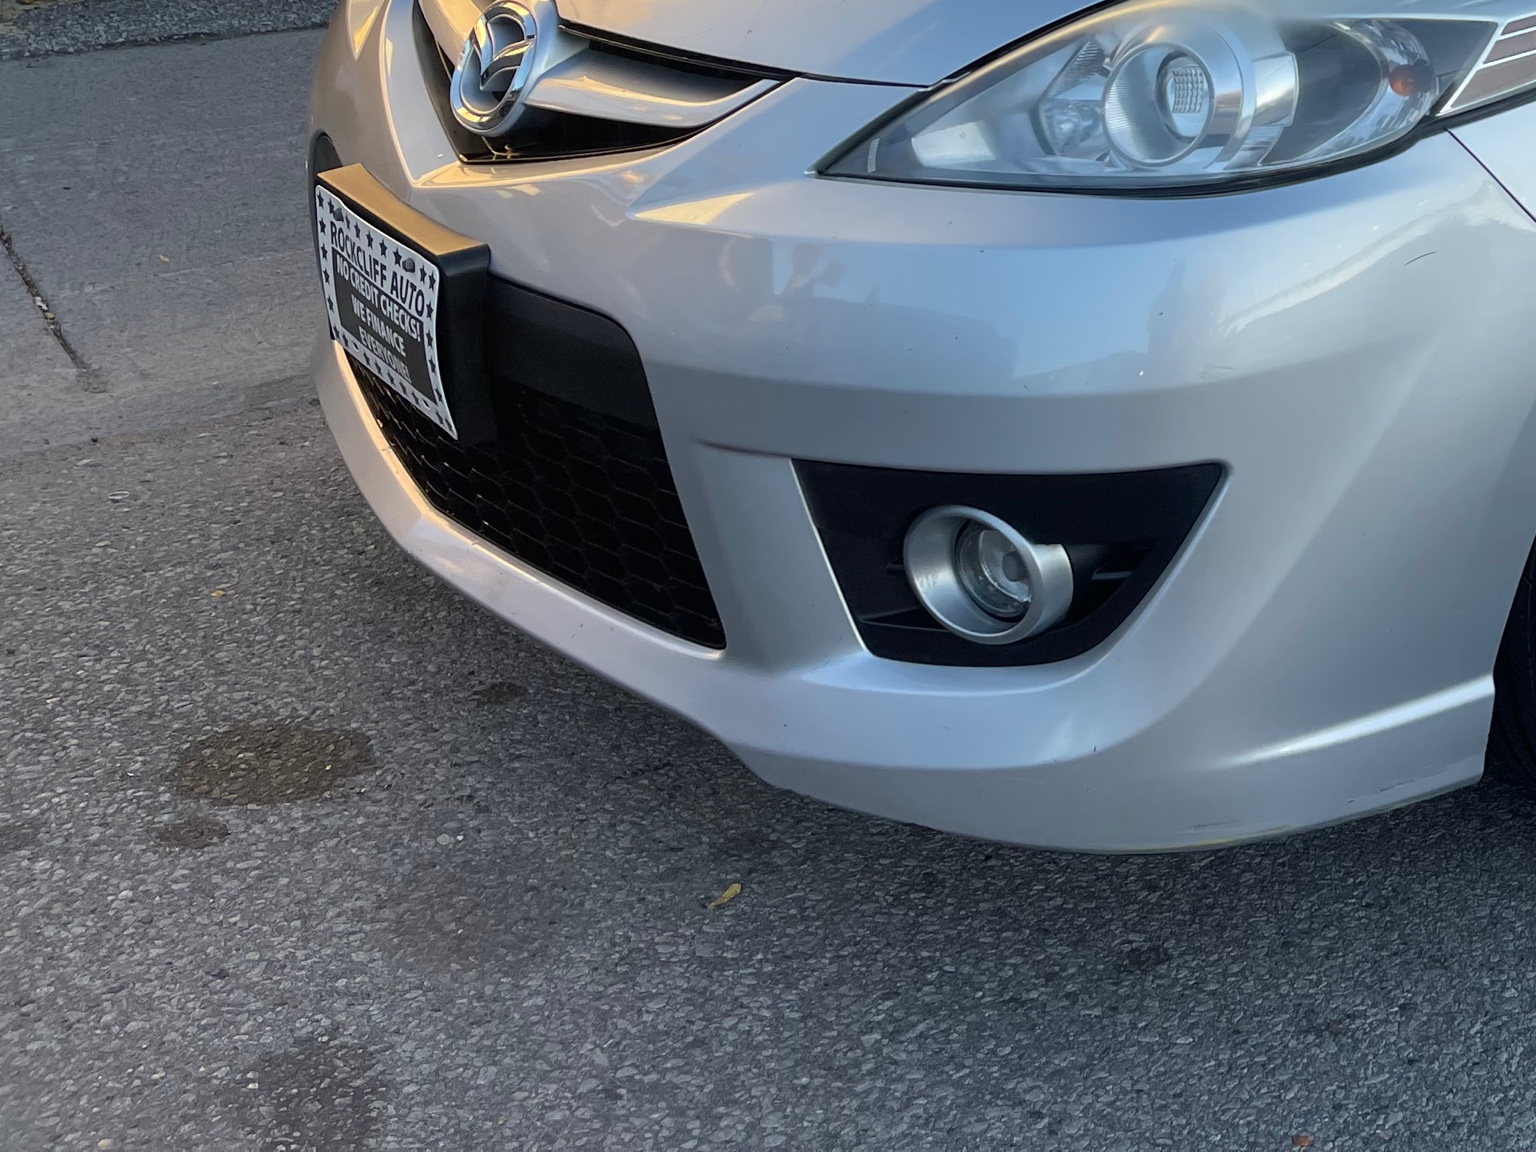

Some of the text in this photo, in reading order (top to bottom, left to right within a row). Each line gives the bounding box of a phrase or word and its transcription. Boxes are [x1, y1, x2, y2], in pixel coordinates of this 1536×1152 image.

[330, 221, 425, 318] ROCKCLIFF AUTO
[336, 254, 421, 343] NO CREDIT CHECKS!
[351, 294, 406, 357] WE FINANCE
[358, 326, 413, 384] EVERYONE!
